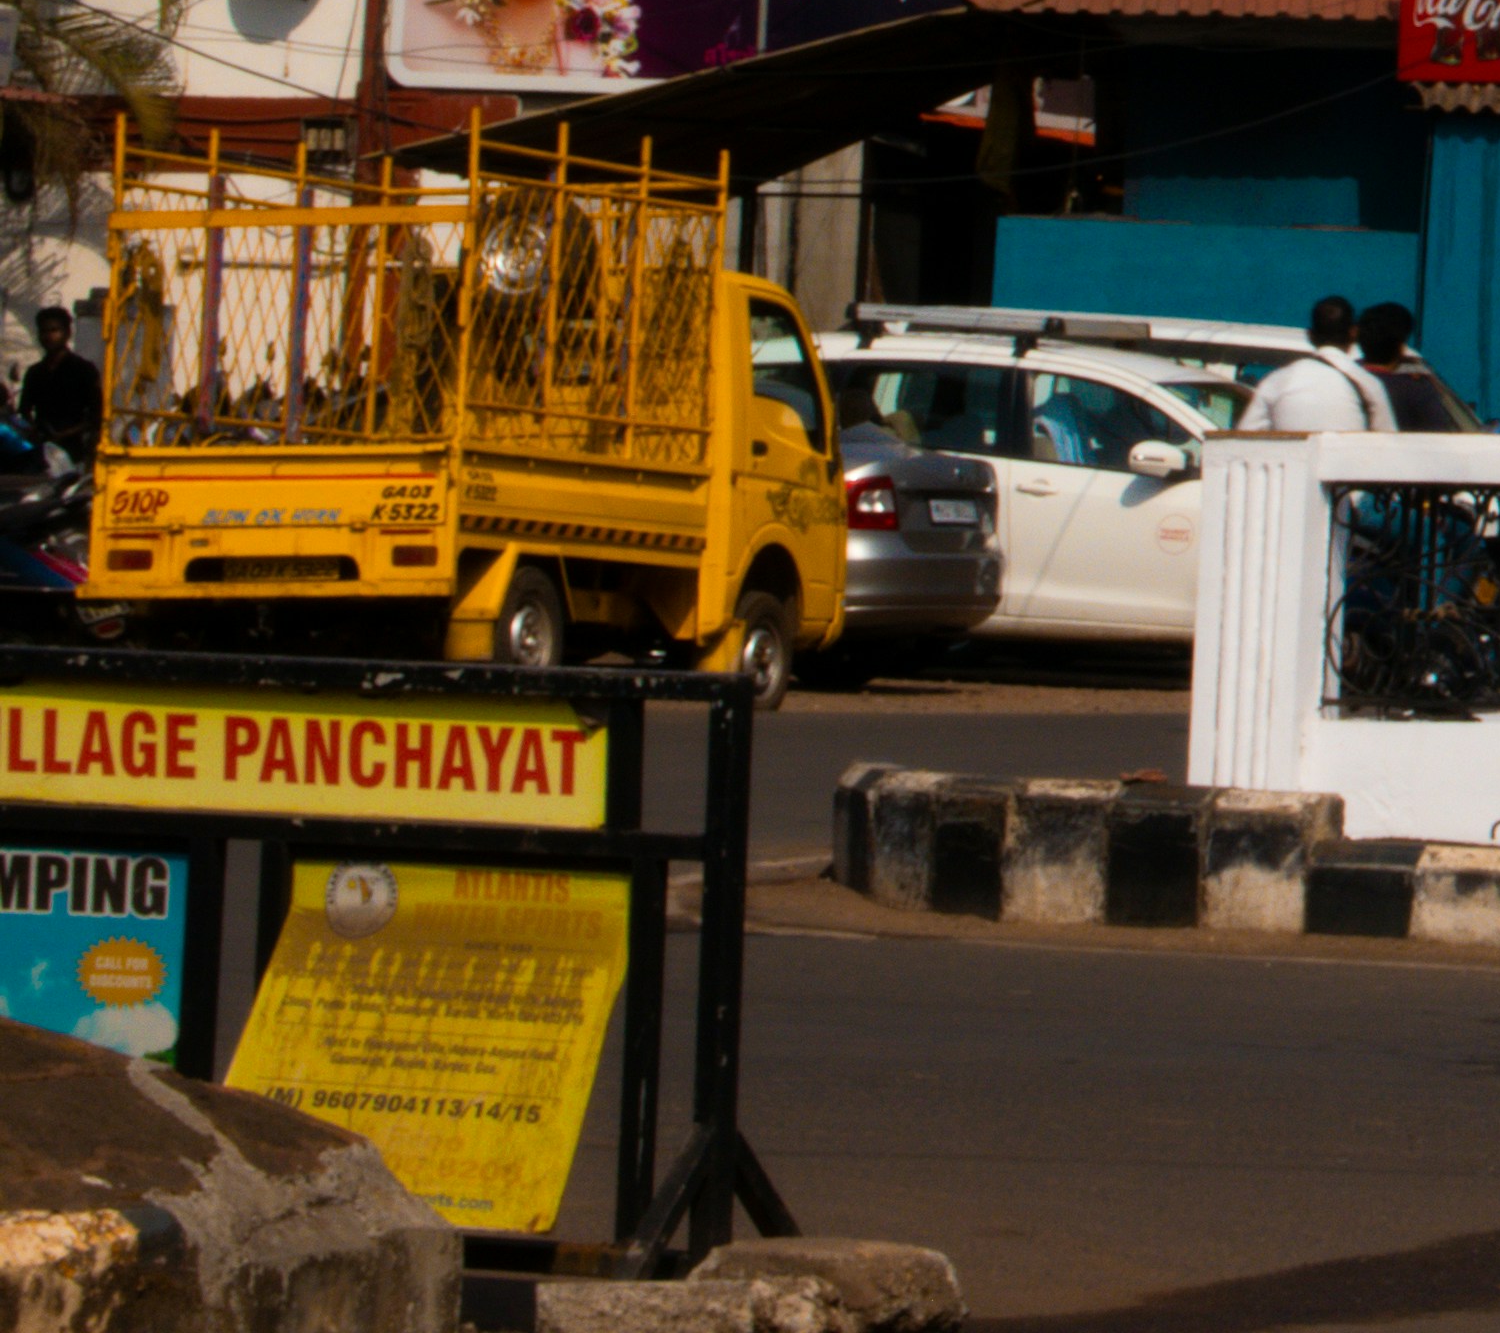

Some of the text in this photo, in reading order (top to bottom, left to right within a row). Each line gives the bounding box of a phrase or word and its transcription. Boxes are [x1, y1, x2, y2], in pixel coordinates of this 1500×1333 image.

[223, 715, 587, 796] PANCHAYAT
[454, 868, 571, 905] ATLANTIS
[502, 907, 603, 939] SPORTS
[94, 956, 149, 970] CALL FOR
[89, 974, 153, 989] DISCOUNTS
[264, 1086, 543, 1124] (M) 9607904113/14/15
